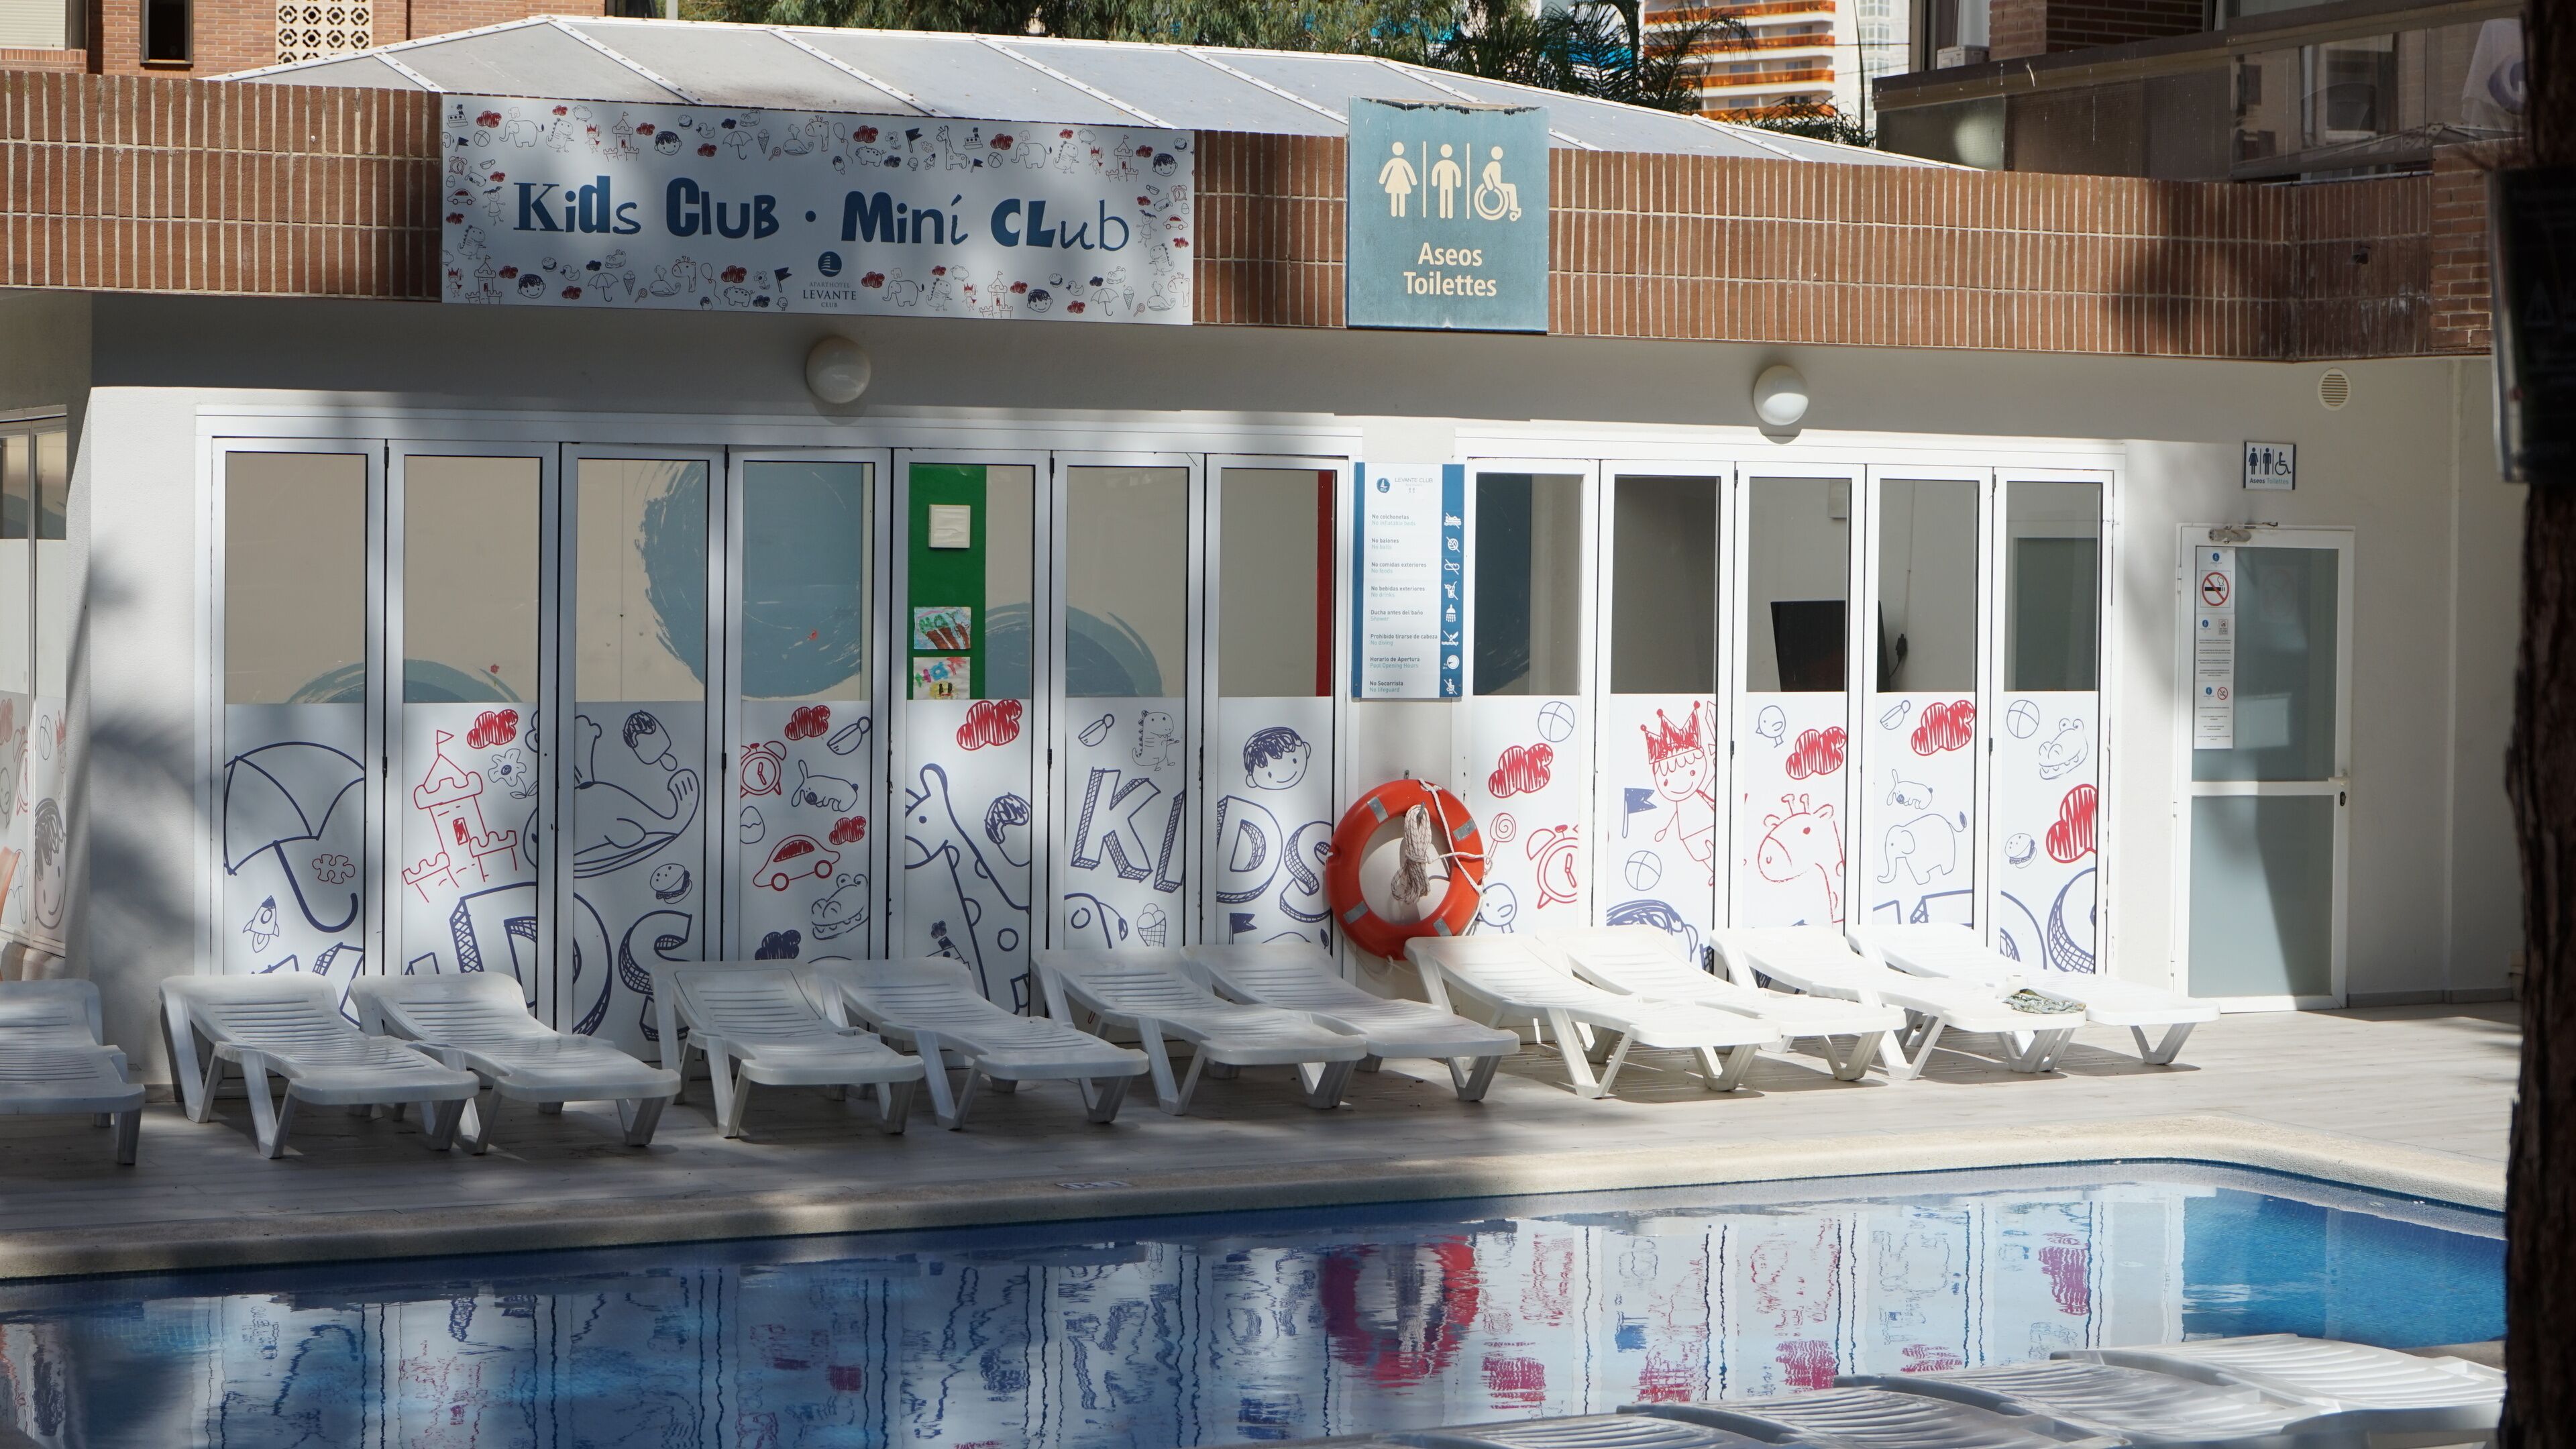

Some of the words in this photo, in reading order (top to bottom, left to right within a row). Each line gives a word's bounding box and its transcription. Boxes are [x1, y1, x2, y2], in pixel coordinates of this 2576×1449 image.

[513, 175, 641, 235] Kids
[1417, 242, 1483, 266] Aseos
[803, 290, 857, 301] LEVANTE
[1403, 271, 1497, 297] Toilettes
